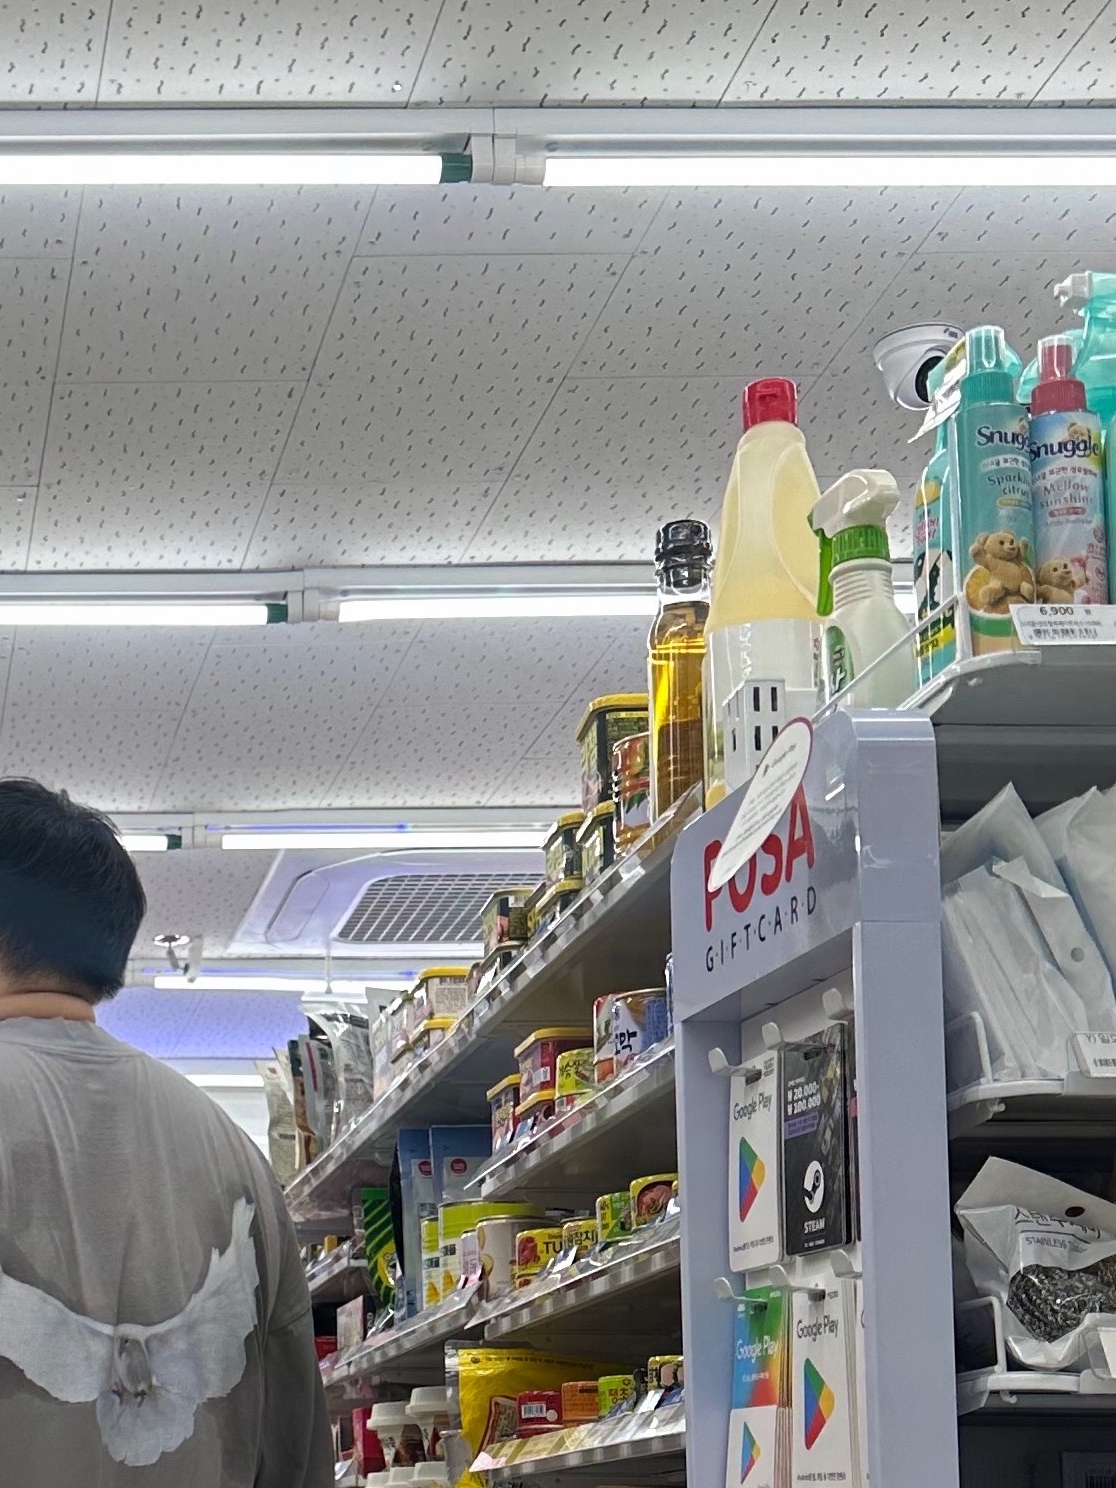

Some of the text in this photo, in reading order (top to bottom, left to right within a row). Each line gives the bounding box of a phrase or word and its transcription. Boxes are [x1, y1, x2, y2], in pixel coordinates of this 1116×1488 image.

[1029, 428, 1101, 461] Snuggle
[1039, 606, 1074, 616] 6,900
[803, 1216, 826, 1235] STEAM
[797, 1317, 840, 1343] Google Play
[736, 1338, 780, 1364] Google Play
